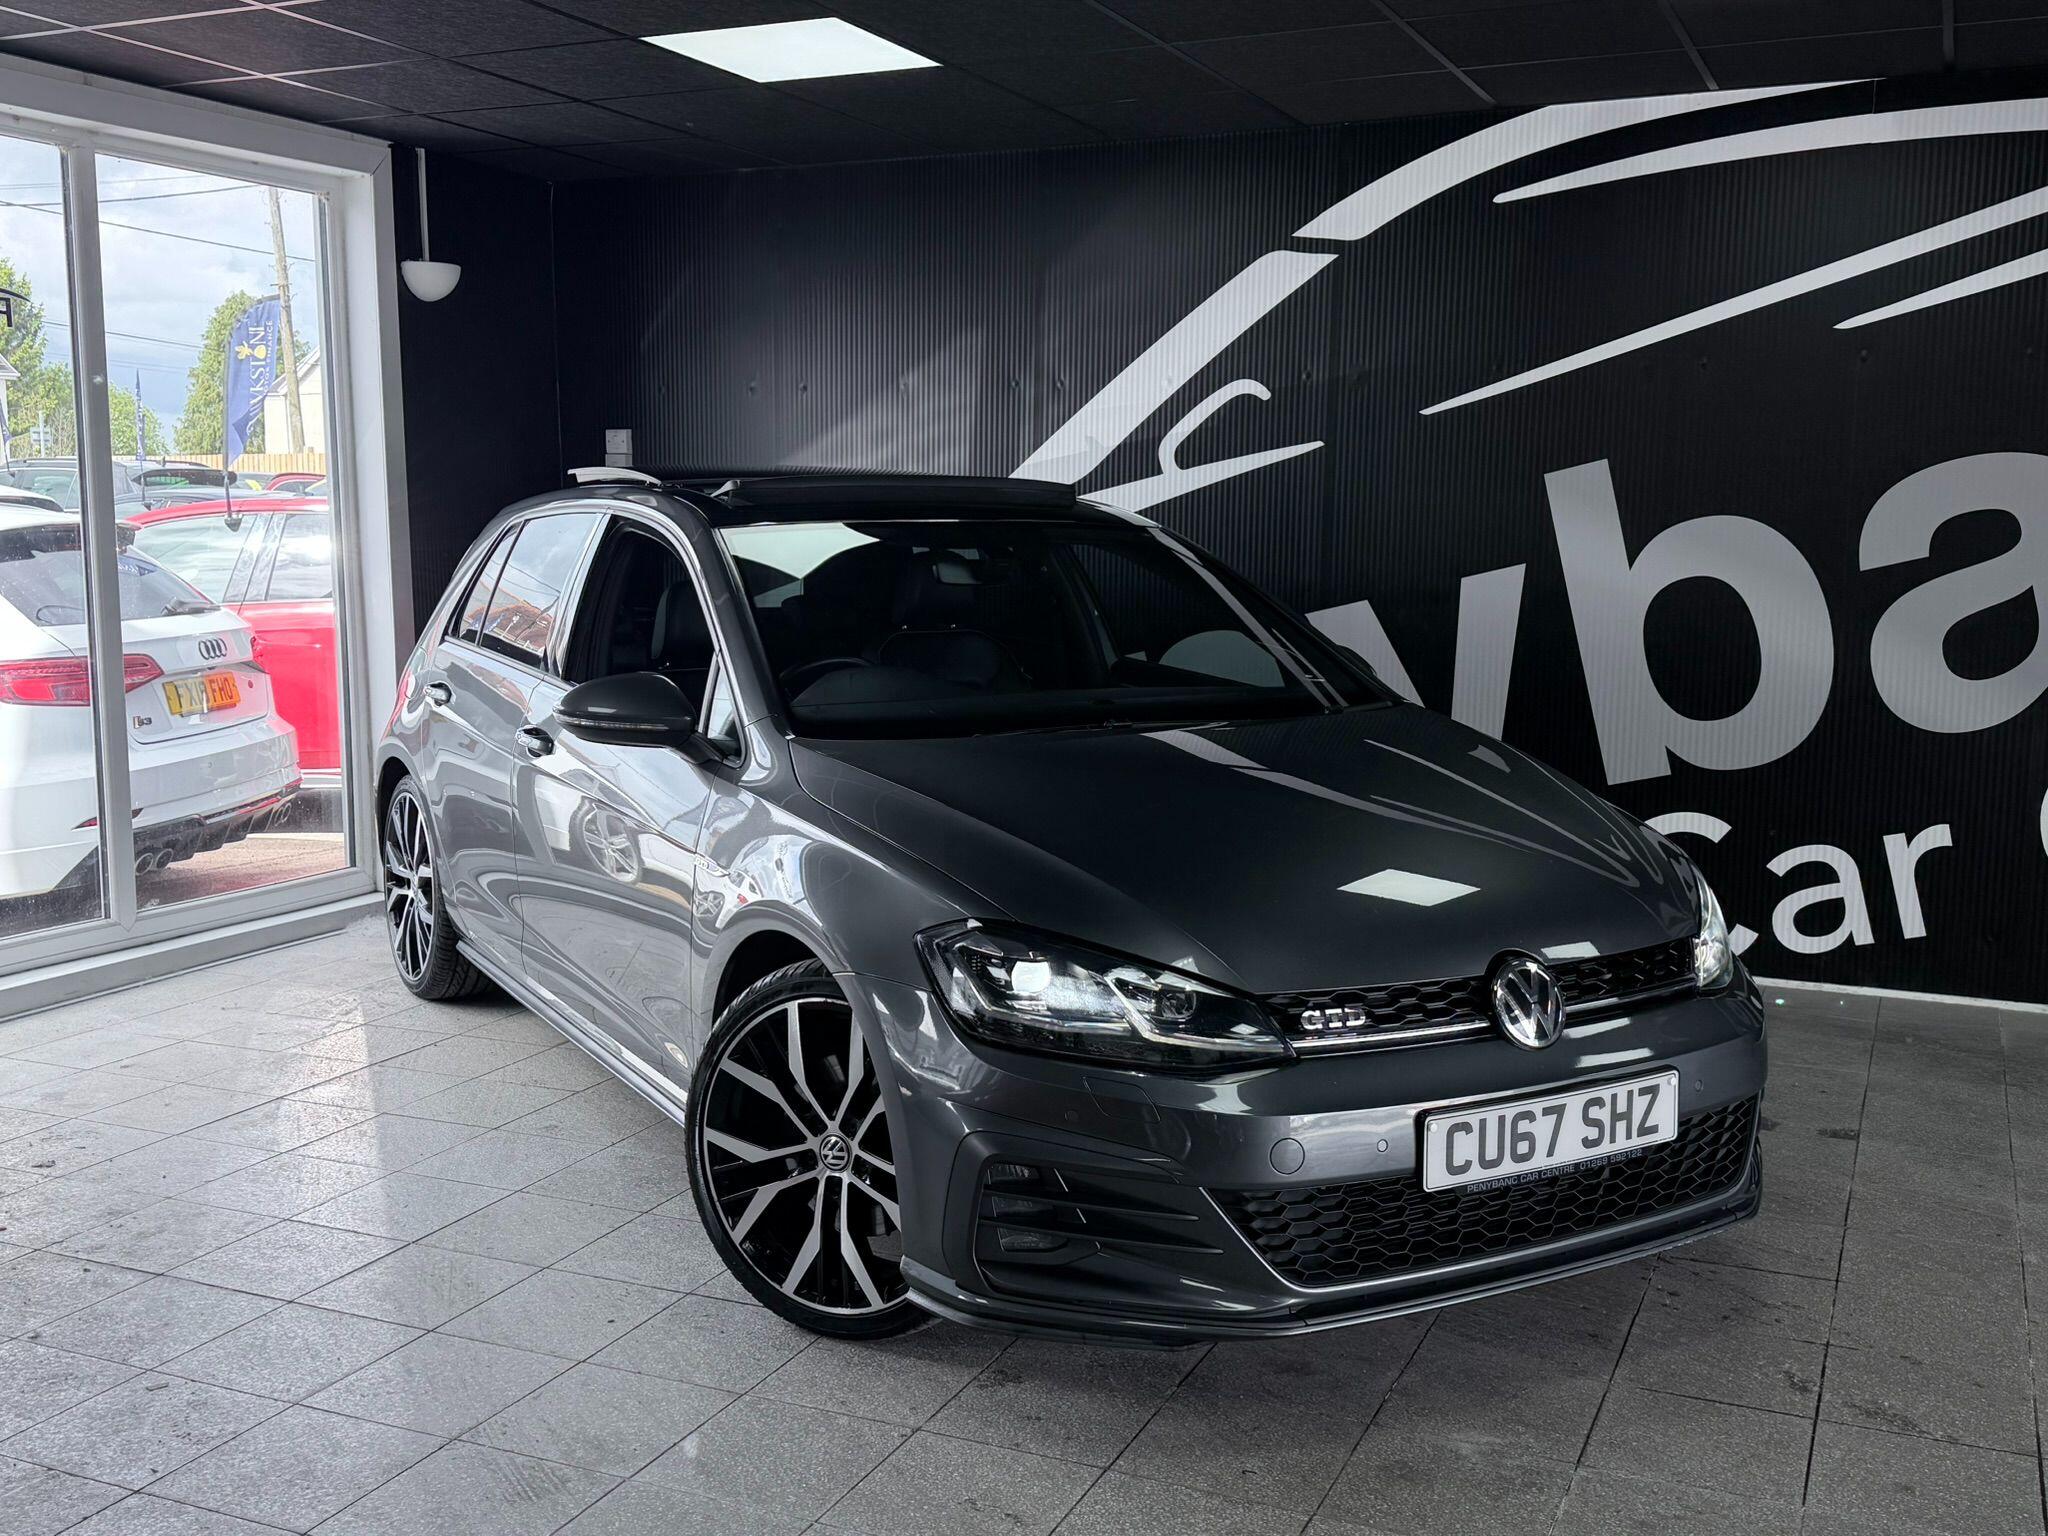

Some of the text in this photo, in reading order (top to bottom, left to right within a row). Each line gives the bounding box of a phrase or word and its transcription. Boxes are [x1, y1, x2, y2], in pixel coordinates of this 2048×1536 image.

[264, 319, 274, 363] FINANCE
[1300, 1005, 1366, 1032] GTD
[1444, 1084, 1661, 1177] CU67 SHZ
[1467, 1149, 1643, 1193] PENYBANC CAR CENTRE 01269 592122
